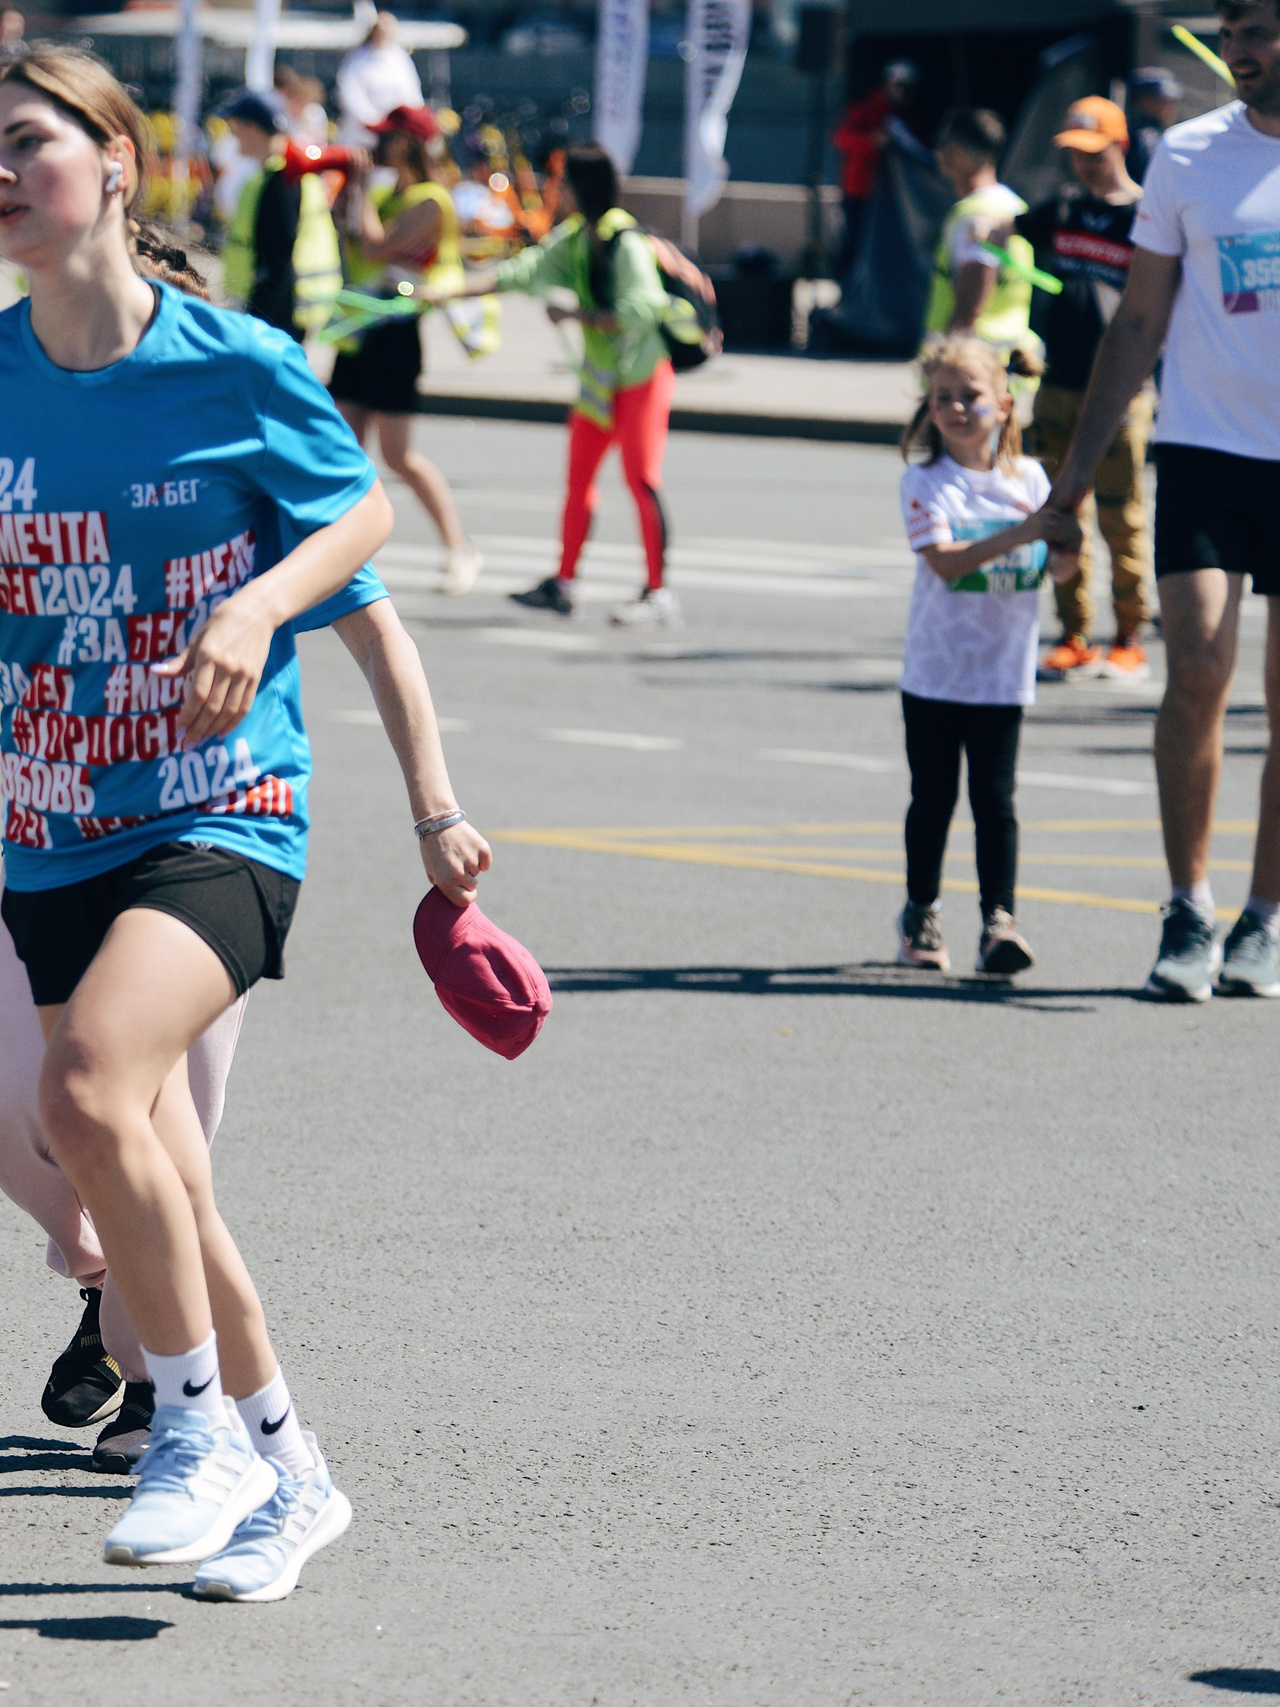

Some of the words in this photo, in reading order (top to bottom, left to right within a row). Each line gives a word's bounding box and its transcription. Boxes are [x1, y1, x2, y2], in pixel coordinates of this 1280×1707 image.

[12, 705, 188, 767] #ГОРДОСТ
[158, 737, 262, 811] 2024
[80, 1333, 101, 1348] PUM
